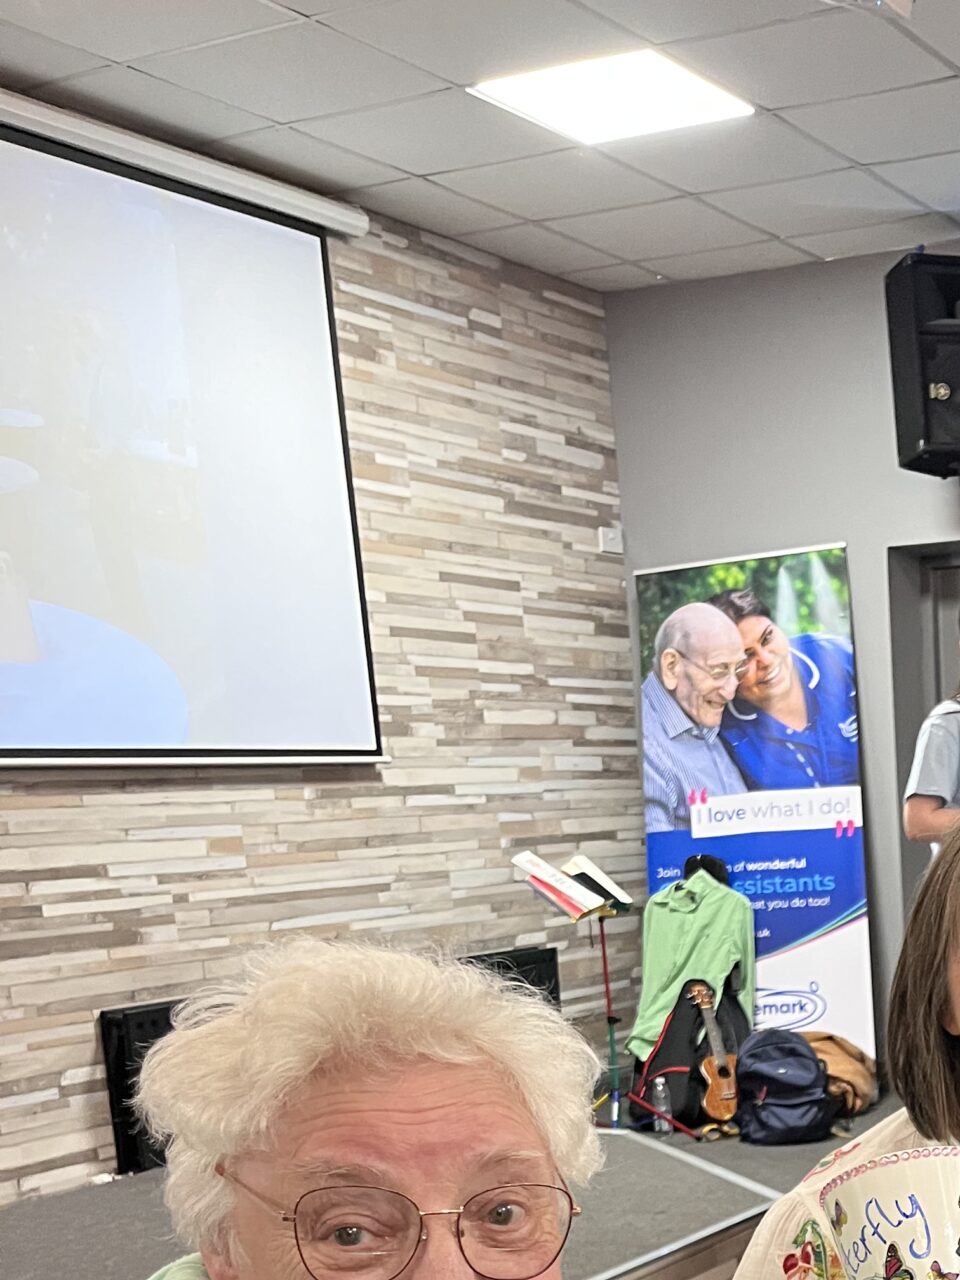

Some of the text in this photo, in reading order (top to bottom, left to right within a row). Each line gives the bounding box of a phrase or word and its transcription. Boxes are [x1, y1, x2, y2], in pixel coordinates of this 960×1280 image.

[708, 806, 746, 823] love
[752, 801, 804, 819] what
[656, 866, 681, 879] Join
[733, 860, 746, 873] of
[745, 857, 807, 872] wonderful
[733, 873, 836, 895] ssistants
[767, 899, 789, 912] you
[790, 896, 807, 908] do
[808, 895, 831, 907] too!
[753, 999, 809, 1016] emark
